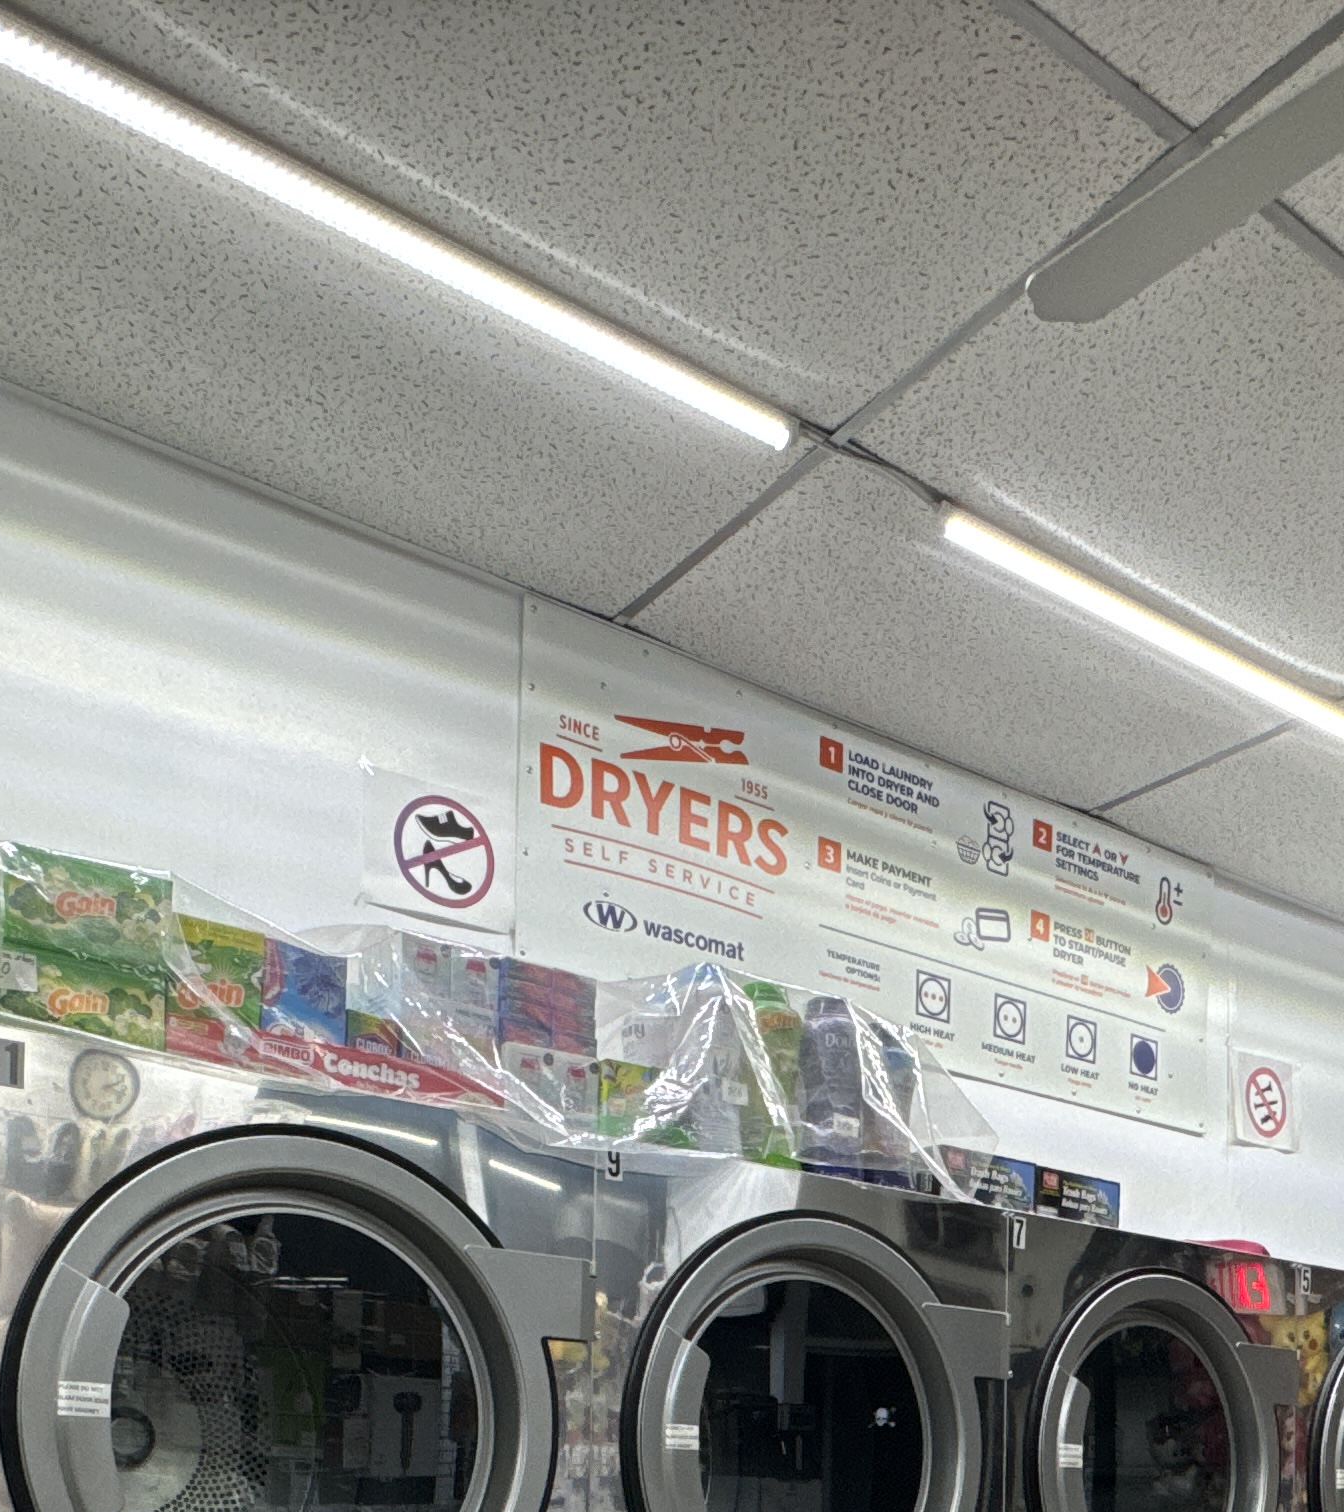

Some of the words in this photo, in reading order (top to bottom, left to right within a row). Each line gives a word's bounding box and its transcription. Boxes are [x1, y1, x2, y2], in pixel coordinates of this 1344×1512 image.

[559, 714, 600, 741] SINCE
[828, 746, 836, 764] 1
[848, 749, 879, 771] LOAD
[881, 762, 933, 792] LAUNDRY
[741, 778, 768, 800] 1955
[848, 765, 875, 783] INTO
[877, 775, 914, 798] DRYER
[916, 791, 940, 808] AND
[848, 780, 883, 801] CLOSE
[886, 794, 918, 815] DOOR
[540, 742, 789, 876] DRYERS
[1038, 827, 1047, 845] 2
[1056, 831, 1091, 852] SELECT
[1104, 850, 1117, 863] OR
[824, 844, 835, 864] 3
[1056, 844, 1075, 861] FOR
[1078, 852, 1140, 885] TEMPERATURE
[564, 838, 629, 865] SELF
[648, 858, 756, 907] SERVICE
[846, 849, 878, 869] MAKE
[881, 862, 932, 887] PAYMENT
[846, 864, 868, 879] Insert
[870, 871, 892, 888] Coins
[893, 880, 901, 889] or
[1056, 858, 1099, 882] SETTINGS
[846, 877, 865, 890] Card
[56, 891, 117, 919] Gain
[1036, 919, 1045, 934] 4
[1053, 921, 1082, 939] PRESS
[1096, 936, 1131, 956] BUTTON
[643, 919, 744, 962] wascomat
[1053, 933, 1066, 947] TO
[1067, 940, 1126, 967] START/PAUSE
[826, 949, 880, 971] TEMPERATURE
[1053, 947, 1084, 966] DRYER
[47, 988, 109, 1017] Gain
[909, 1021, 932, 1038] HIGH
[933, 1027, 955, 1042] HEAT
[263, 1041, 313, 1065] BIMBO
[981, 1041, 1014, 1060] MEDIUM
[1016, 1049, 1036, 1064] HEAT
[323, 1051, 420, 1089] Conchas
[1060, 1063, 1079, 1075] LOW
[1080, 1069, 1100, 1081] HEAT
[1128, 1081, 1139, 1092] NO
[1141, 1084, 1158, 1096] HEAT
[1016, 1219, 1024, 1246] 7
[1303, 1270, 1309, 1292] 5
